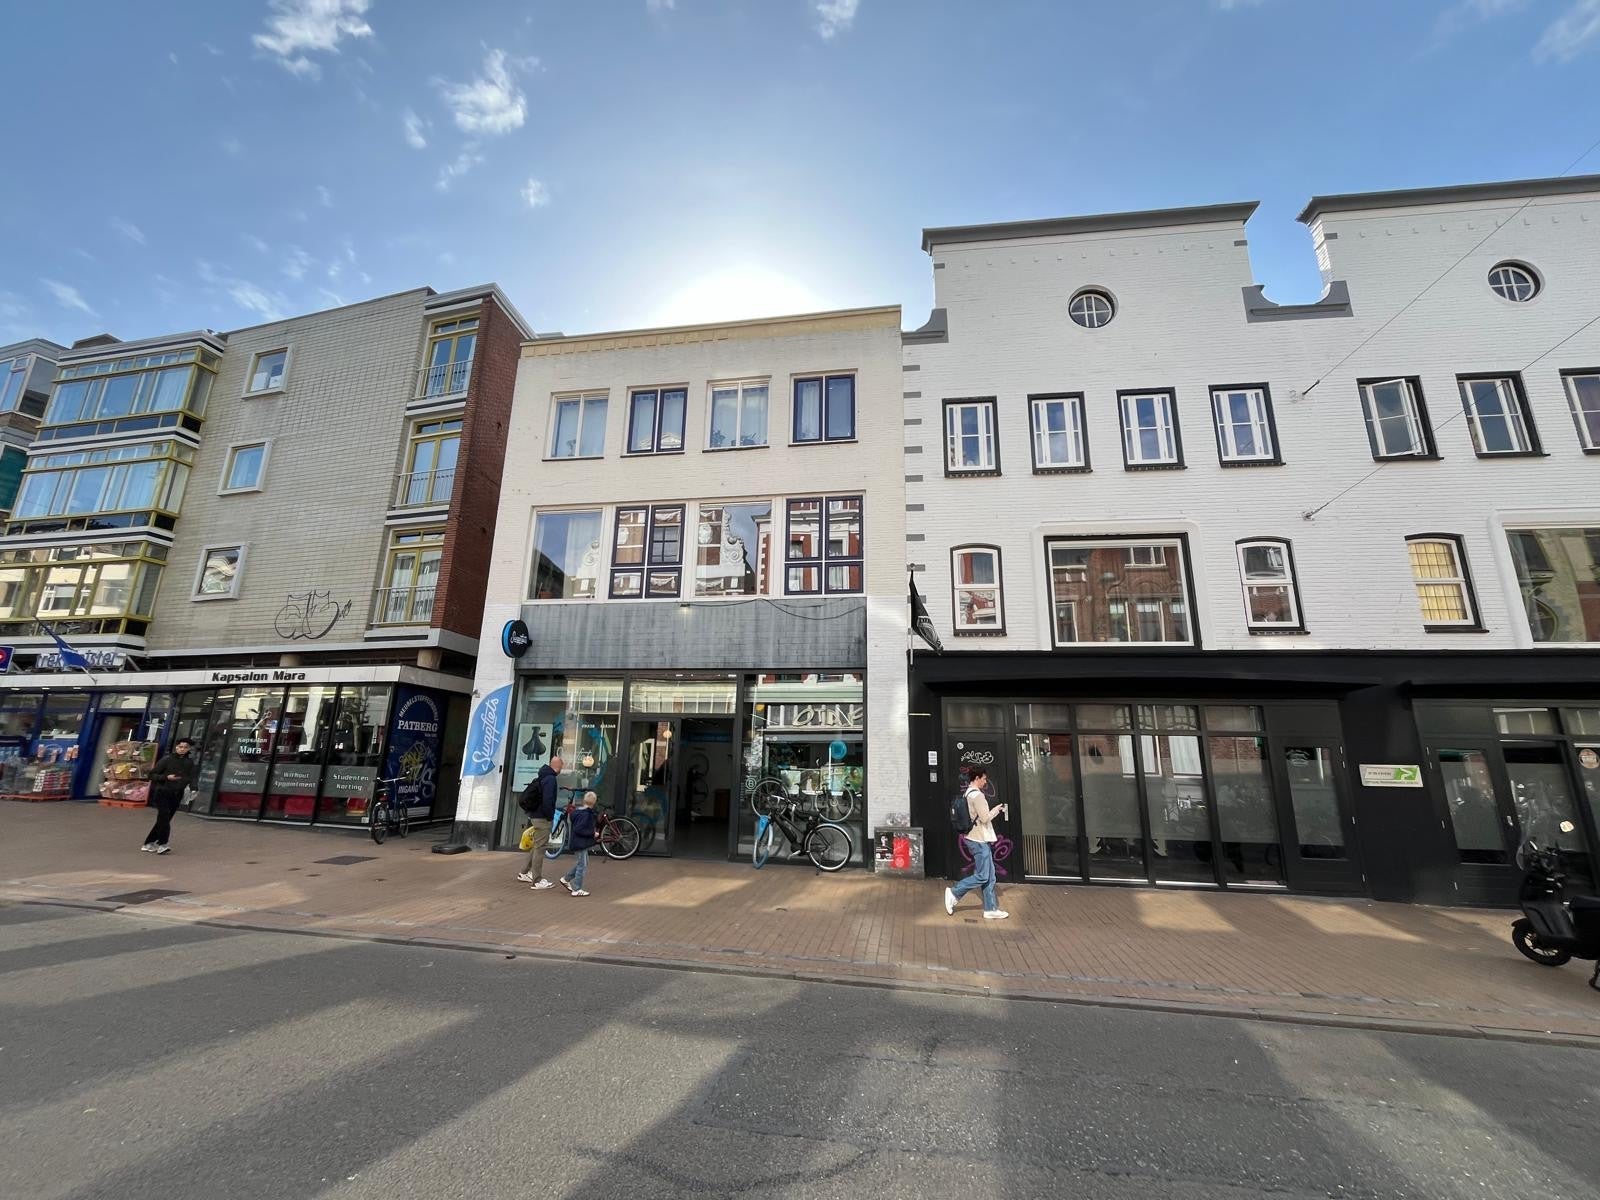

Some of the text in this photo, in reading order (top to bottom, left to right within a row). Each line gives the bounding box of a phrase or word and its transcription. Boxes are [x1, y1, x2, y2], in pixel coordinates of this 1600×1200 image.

[212, 671, 306, 683] Kapsalon Mara
[397, 719, 438, 732] PATBERG
[472, 698, 500, 771] Swapfiets
[239, 745, 262, 754] Mara
[333, 773, 369, 781] Studenten
[336, 783, 363, 791] Korting
